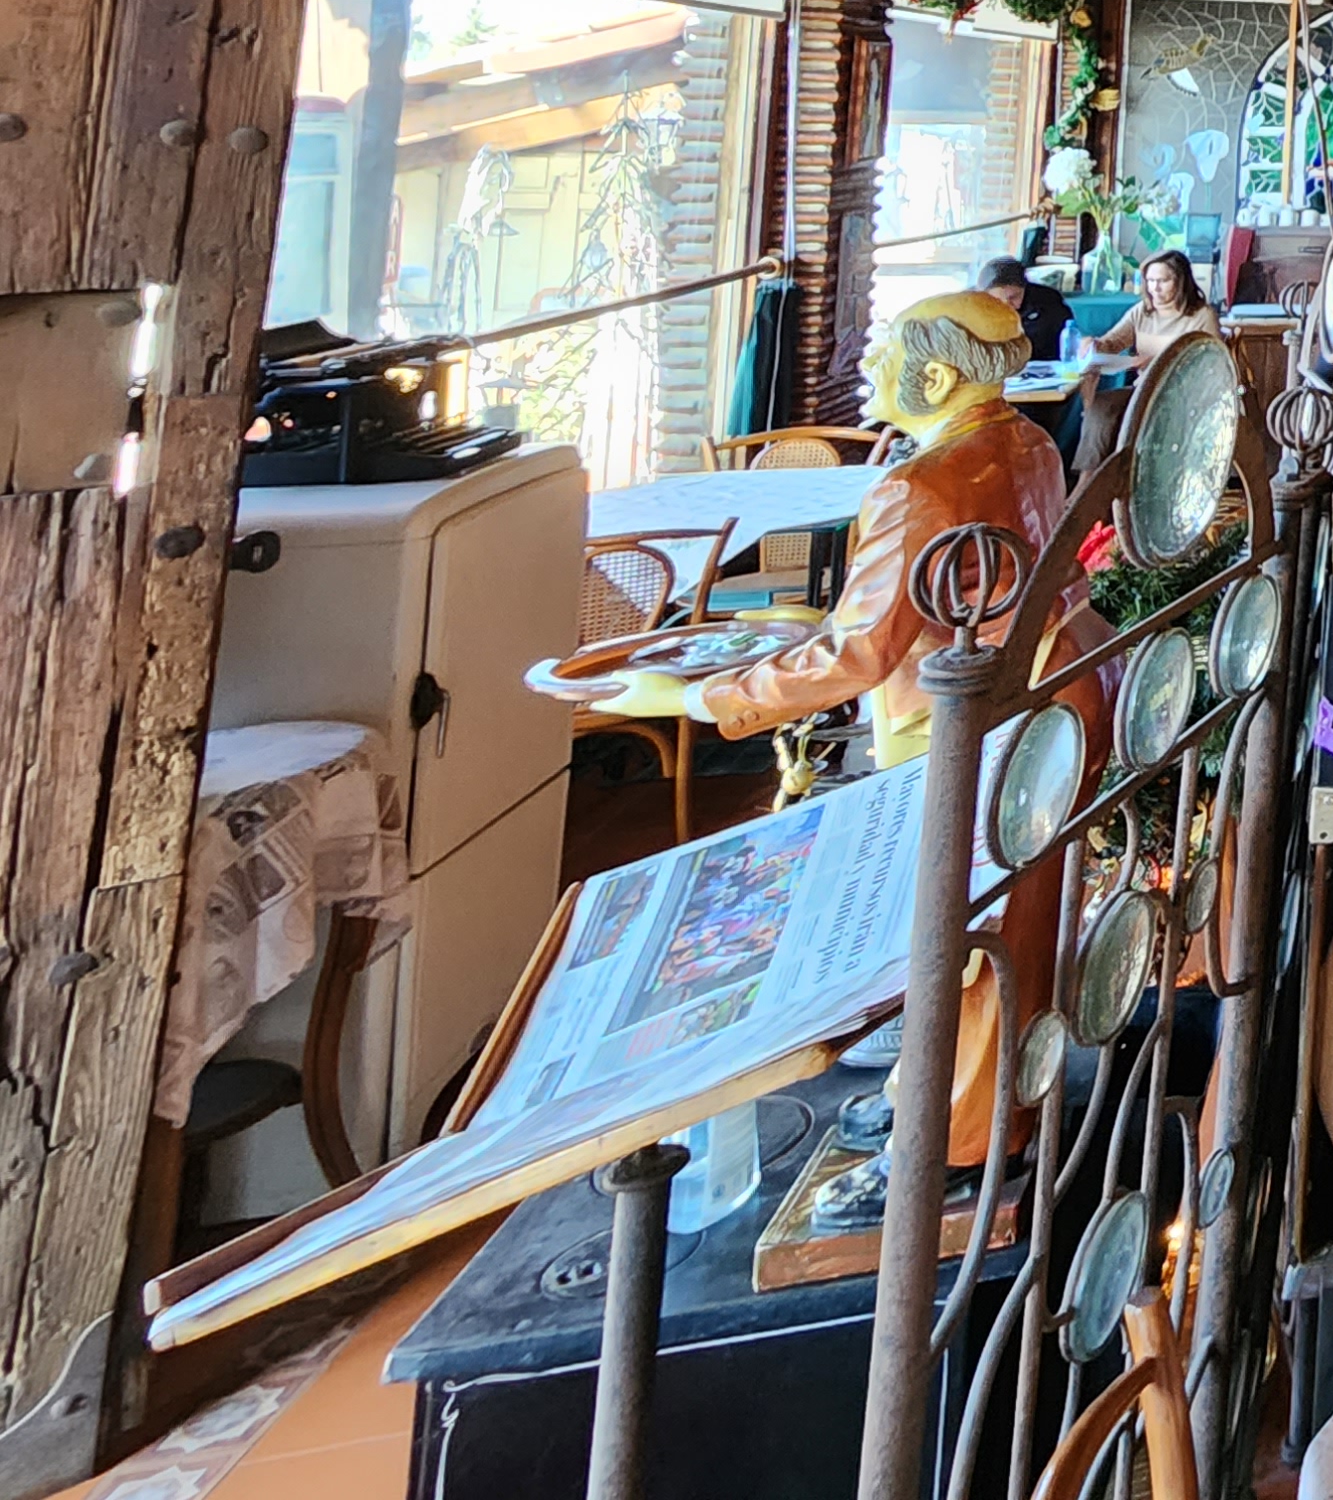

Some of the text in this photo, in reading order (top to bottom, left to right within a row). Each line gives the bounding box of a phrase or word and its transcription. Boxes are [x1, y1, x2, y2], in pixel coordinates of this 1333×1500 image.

[855, 777, 892, 866] seguridad
[887, 765, 924, 841] Mayores
[863, 839, 899, 916] recursos
[813, 877, 862, 986] municipios
[849, 913, 883, 958] irán
